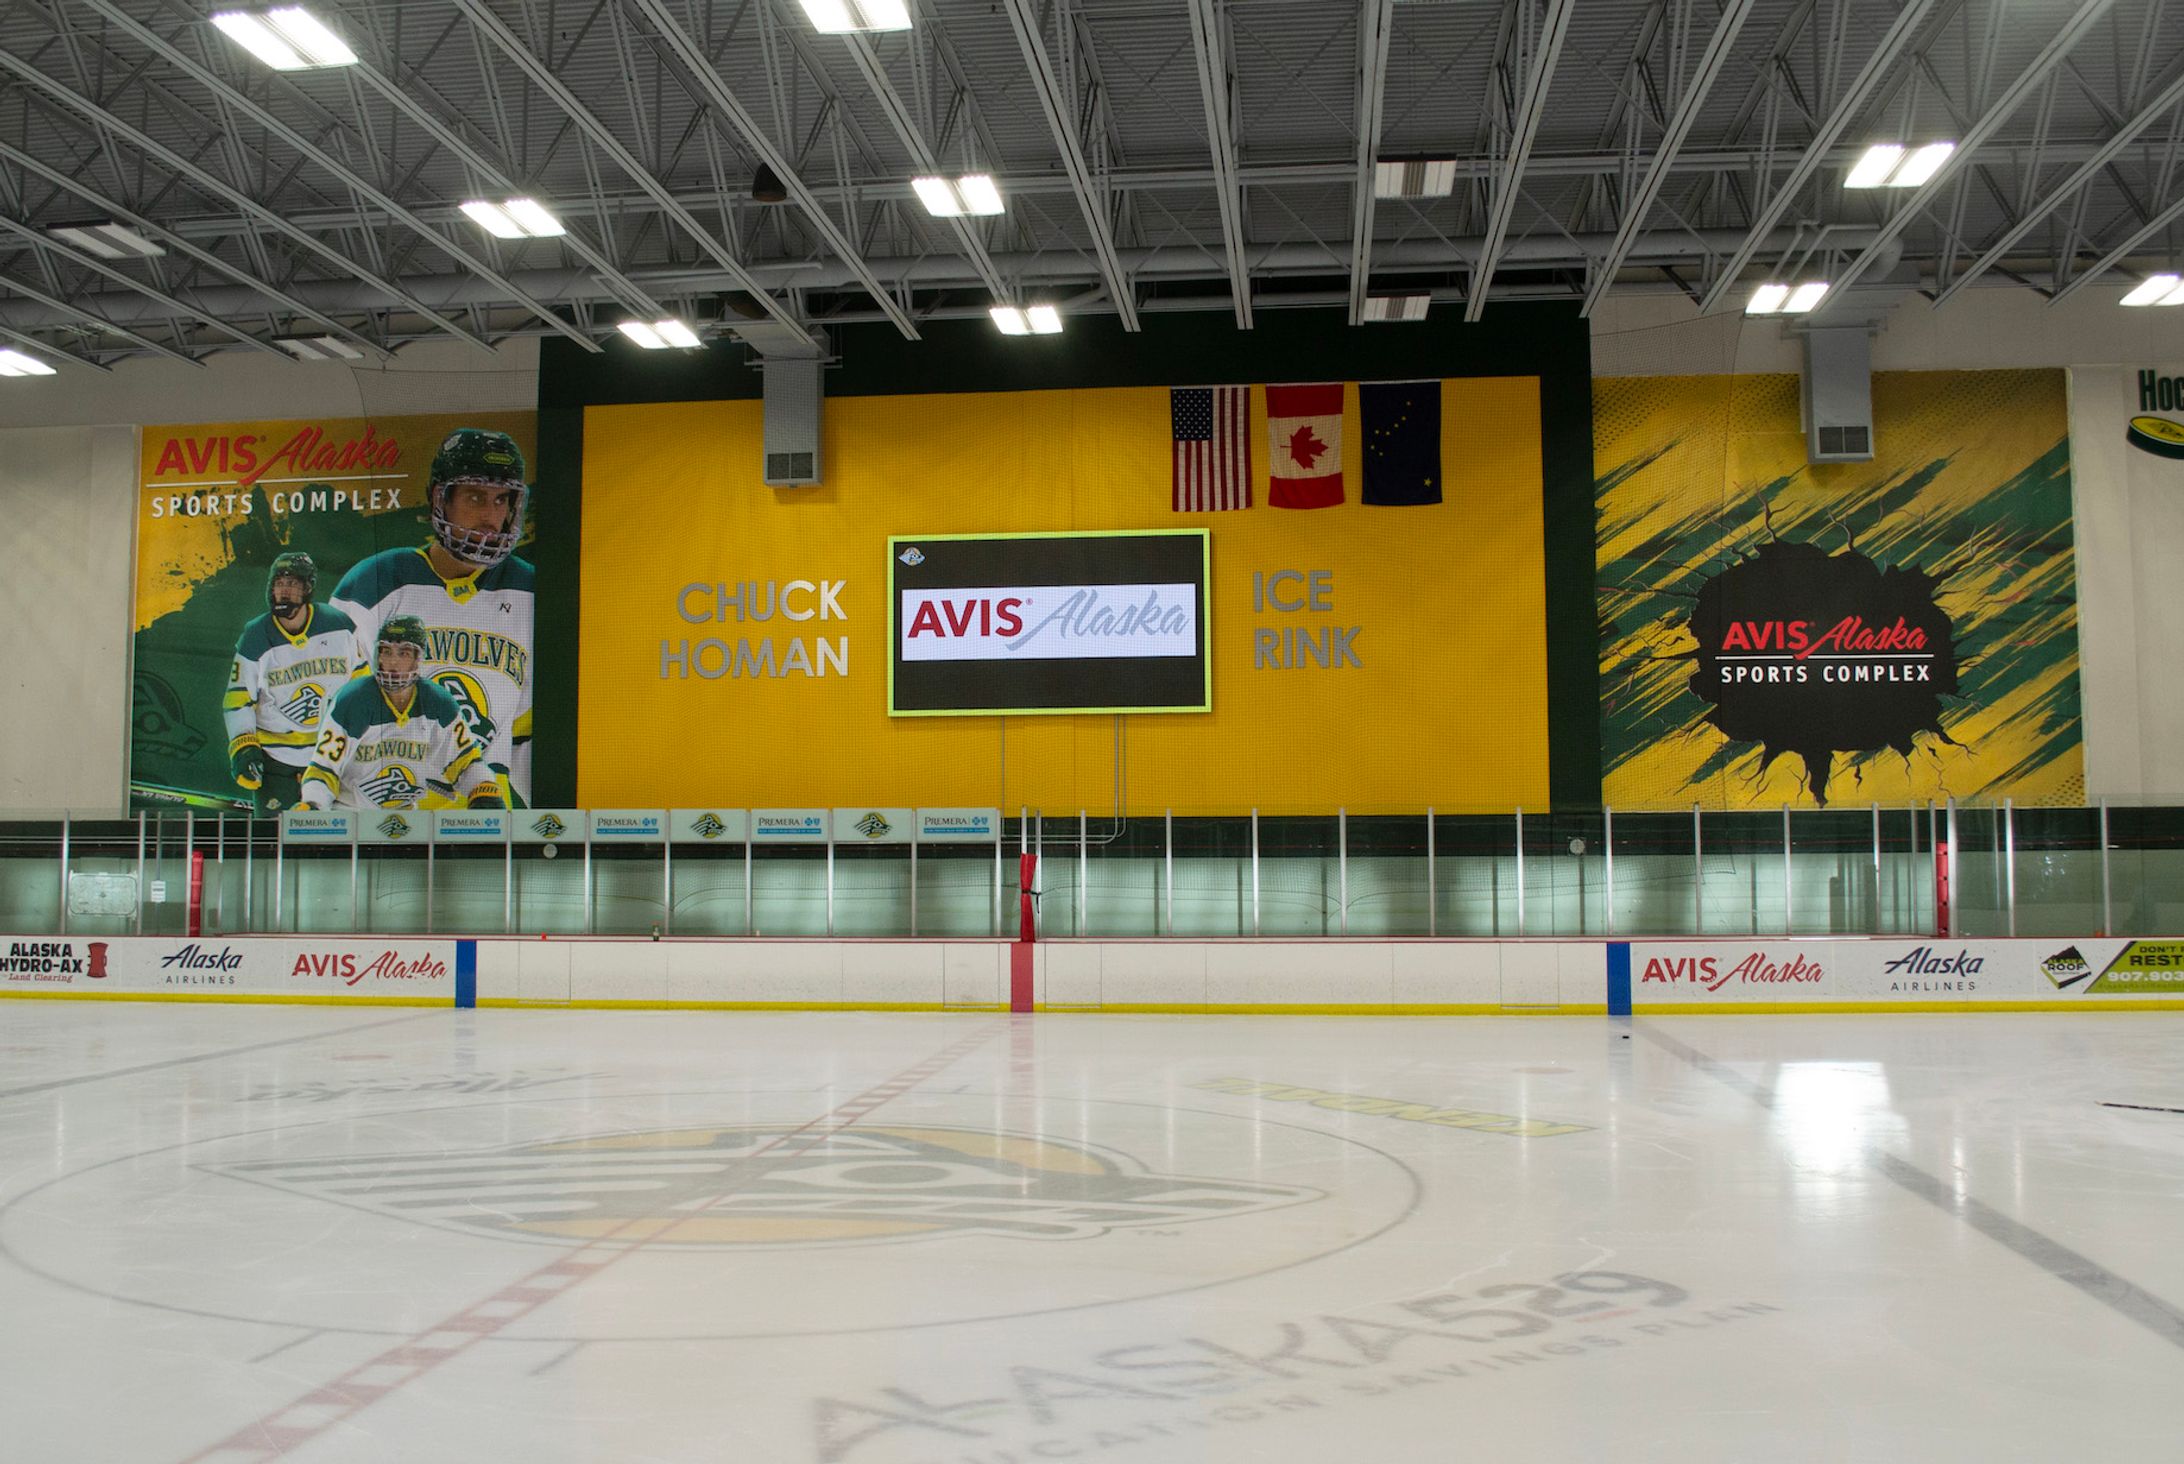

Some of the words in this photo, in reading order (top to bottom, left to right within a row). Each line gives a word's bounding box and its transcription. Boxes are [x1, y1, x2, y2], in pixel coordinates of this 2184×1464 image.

[155, 435, 257, 475] AVIS
[239, 424, 401, 485] Alaska
[152, 493, 253, 518] SPORTS
[273, 488, 401, 514] COMPLEX
[677, 579, 849, 624] CHUCK
[1254, 569, 1332, 613] ICE
[907, 597, 1023, 638] AVIS
[1005, 588, 1190, 651] Alaska
[1255, 626, 1364, 669] RINK
[1722, 620, 1808, 650] AVIS
[1793, 615, 1929, 660] Alaska
[660, 636, 849, 679] HOMAN
[267, 656, 348, 687] SEAWOLVES
[1721, 665, 1808, 683] SPORTS
[1822, 664, 1930, 682] COMPLEX
[317, 728, 347, 762] 23
[289, 817, 328, 829] PREMERA
[441, 817, 481, 828] PREMERA
[597, 816, 639, 828] PREMERA
[758, 816, 801, 828] PREMERA
[924, 815, 969, 827] PREMERA
[10, 943, 73, 957] ALASKA
[161, 943, 243, 972] Alaska
[2139, 945, 2176, 953] DON'T
[0, 958, 84, 973] HYDRO-AX
[291, 953, 357, 977] AVIS
[1884, 946, 1985, 977] Alaska
[2047, 963, 2085, 971] ROOF
[2130, 954, 2184, 966] REST
[8, 973, 31, 981] Land
[34, 973, 73, 984] Clearing
[165, 975, 236, 985] AIRLINES
[1641, 956, 1718, 983] AVIS
[1706, 952, 1825, 992] Alaska
[1890, 981, 1976, 992] AIRLINES
